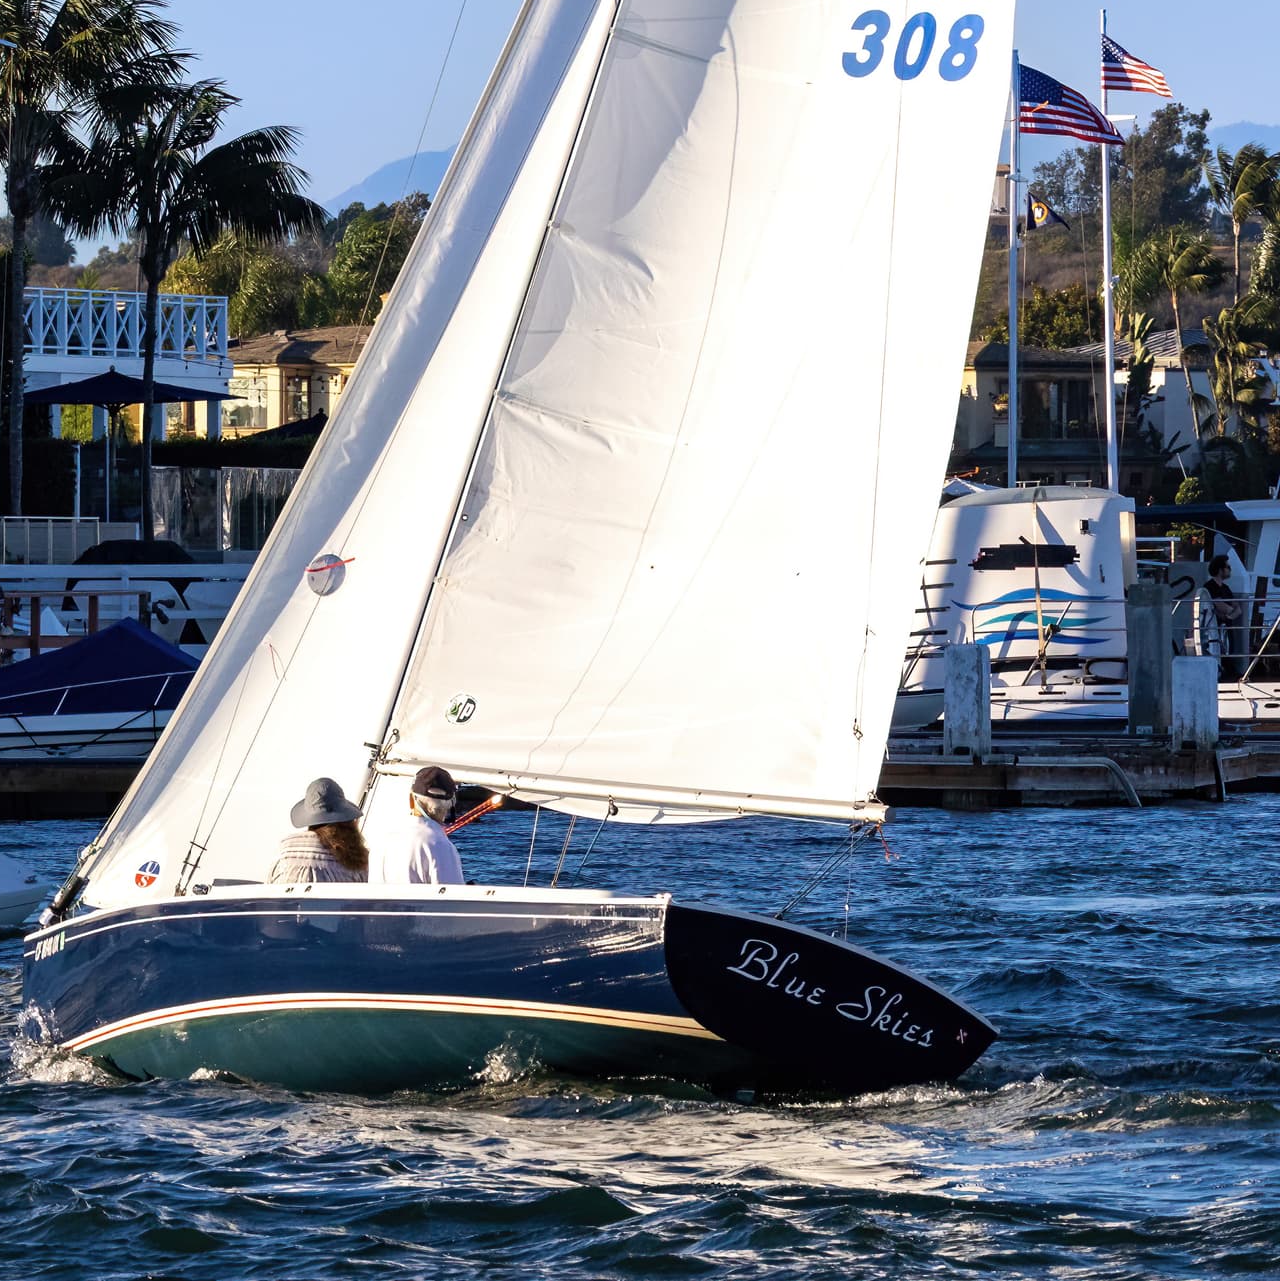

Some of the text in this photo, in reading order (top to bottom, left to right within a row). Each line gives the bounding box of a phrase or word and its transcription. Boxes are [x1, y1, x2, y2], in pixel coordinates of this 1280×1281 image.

[841, 9, 985, 82] 308
[726, 938, 933, 1047] Blue Skies
